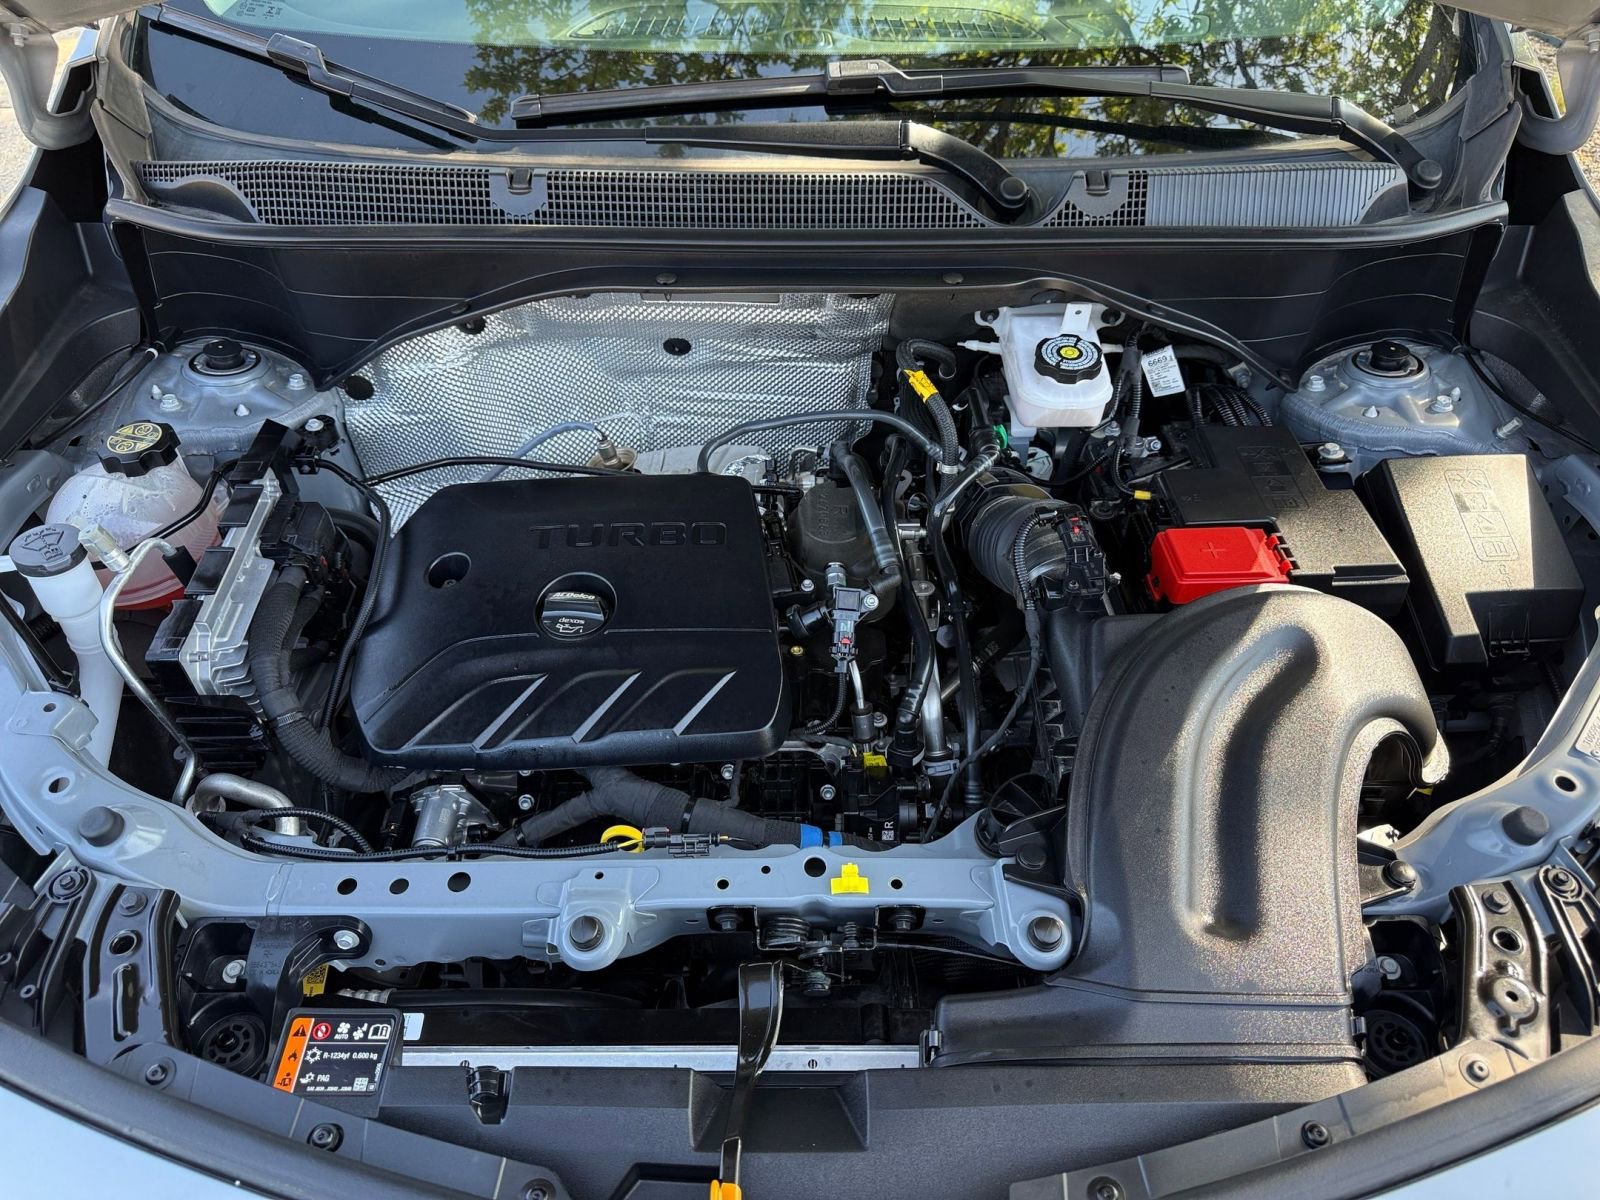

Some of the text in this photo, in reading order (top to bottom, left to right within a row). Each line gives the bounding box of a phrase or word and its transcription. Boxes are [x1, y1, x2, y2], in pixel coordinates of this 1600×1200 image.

[529, 521, 727, 549] TURBO
[551, 591, 596, 600] ACDelco
[323, 1051, 350, 1060] R-1234yf
[369, 1052, 378, 1060] kg
[316, 1074, 331, 1082] PAG
